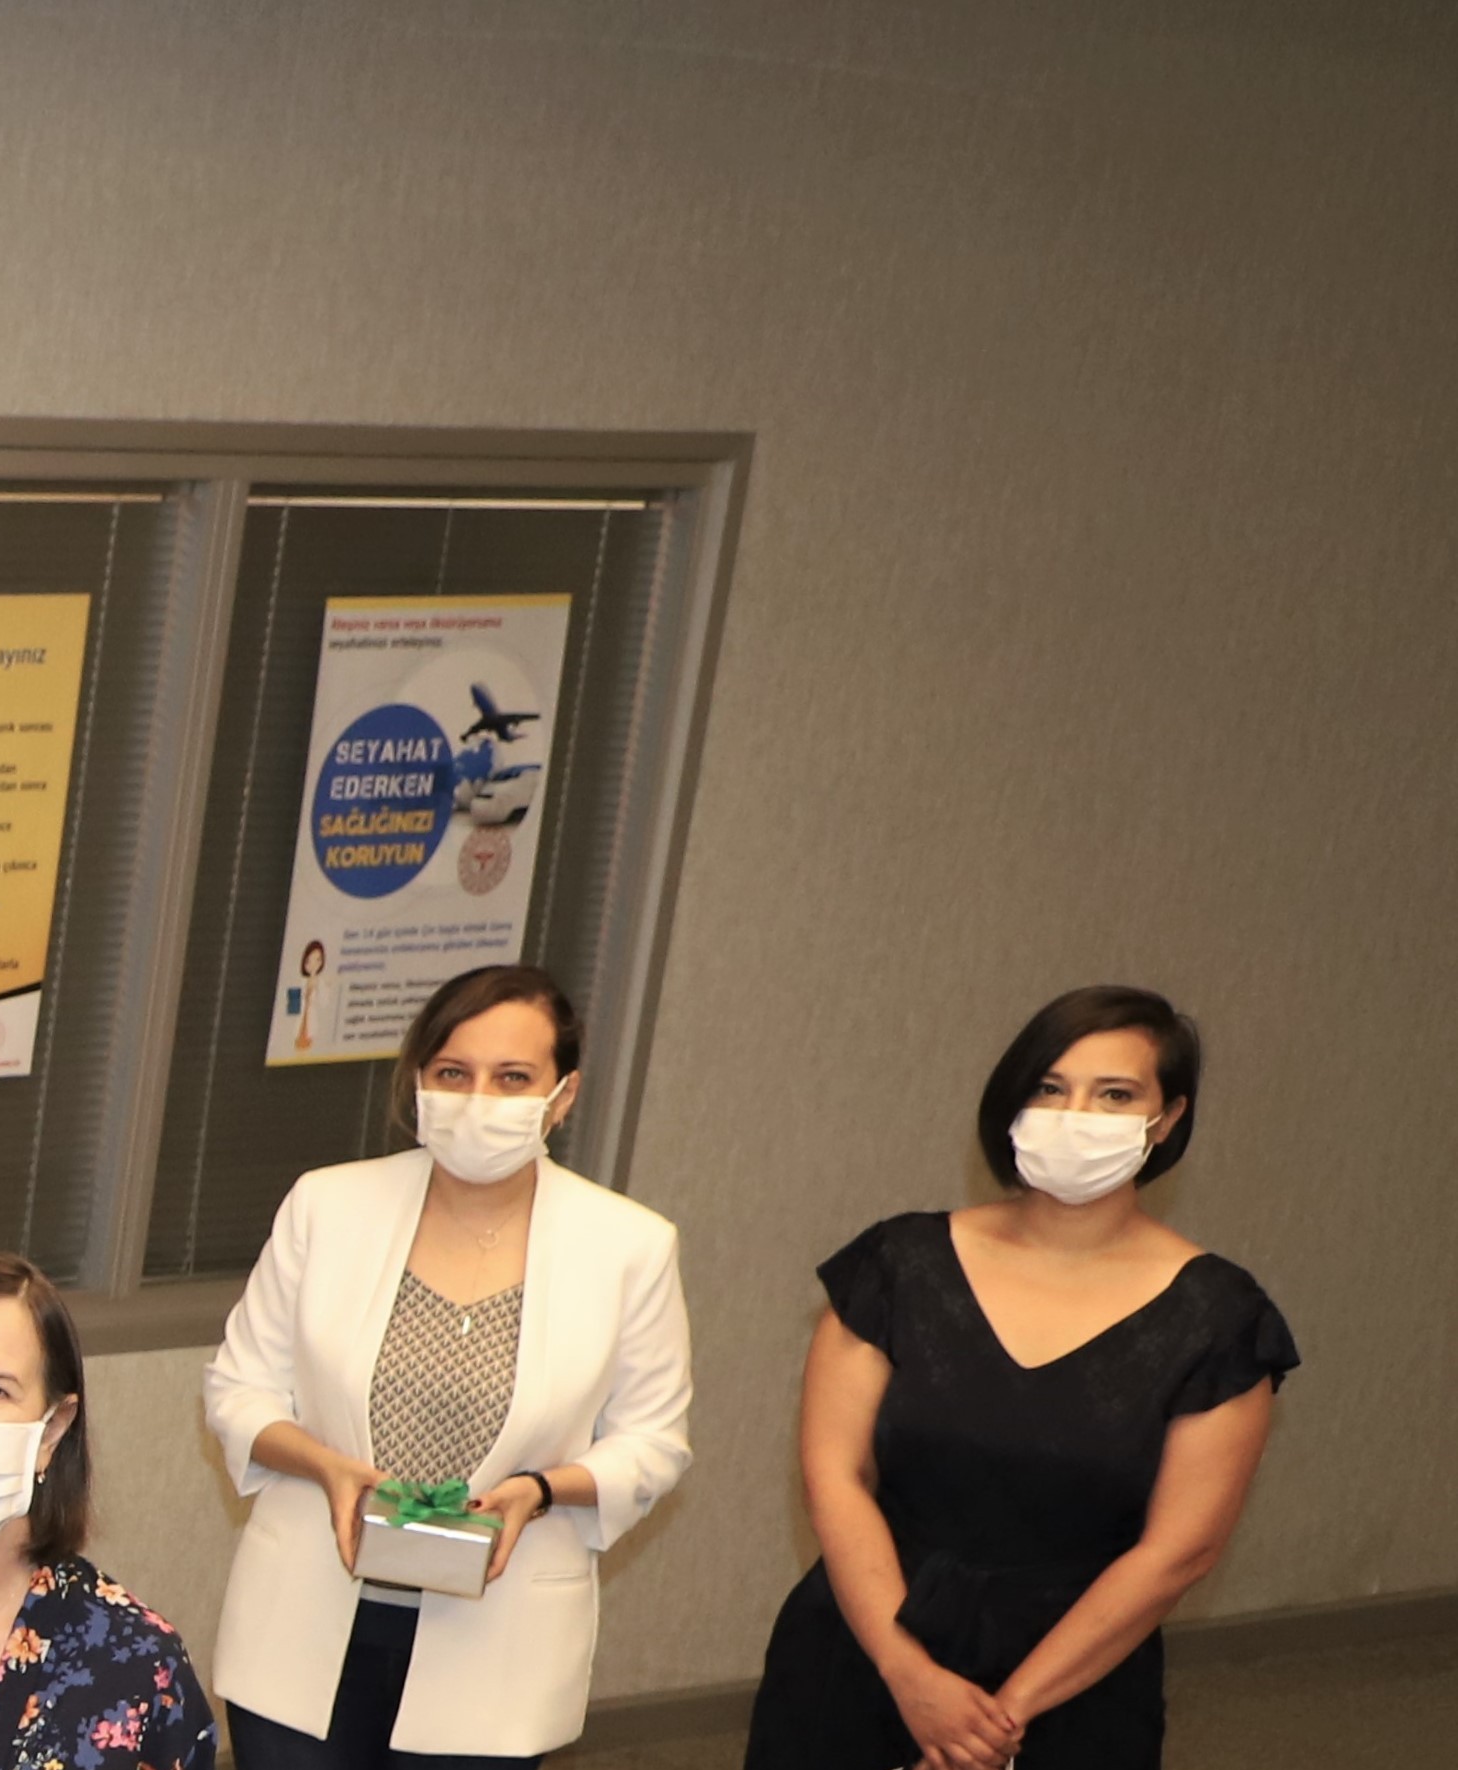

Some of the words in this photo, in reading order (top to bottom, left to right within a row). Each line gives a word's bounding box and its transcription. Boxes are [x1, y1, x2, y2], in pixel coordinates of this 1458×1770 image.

[335, 737, 443, 765] SEYAHAT
[330, 773, 435, 800] EDERKEN
[320, 806, 435, 837] SAĞLIĞINIZI
[326, 844, 425, 869] KORUYUN
